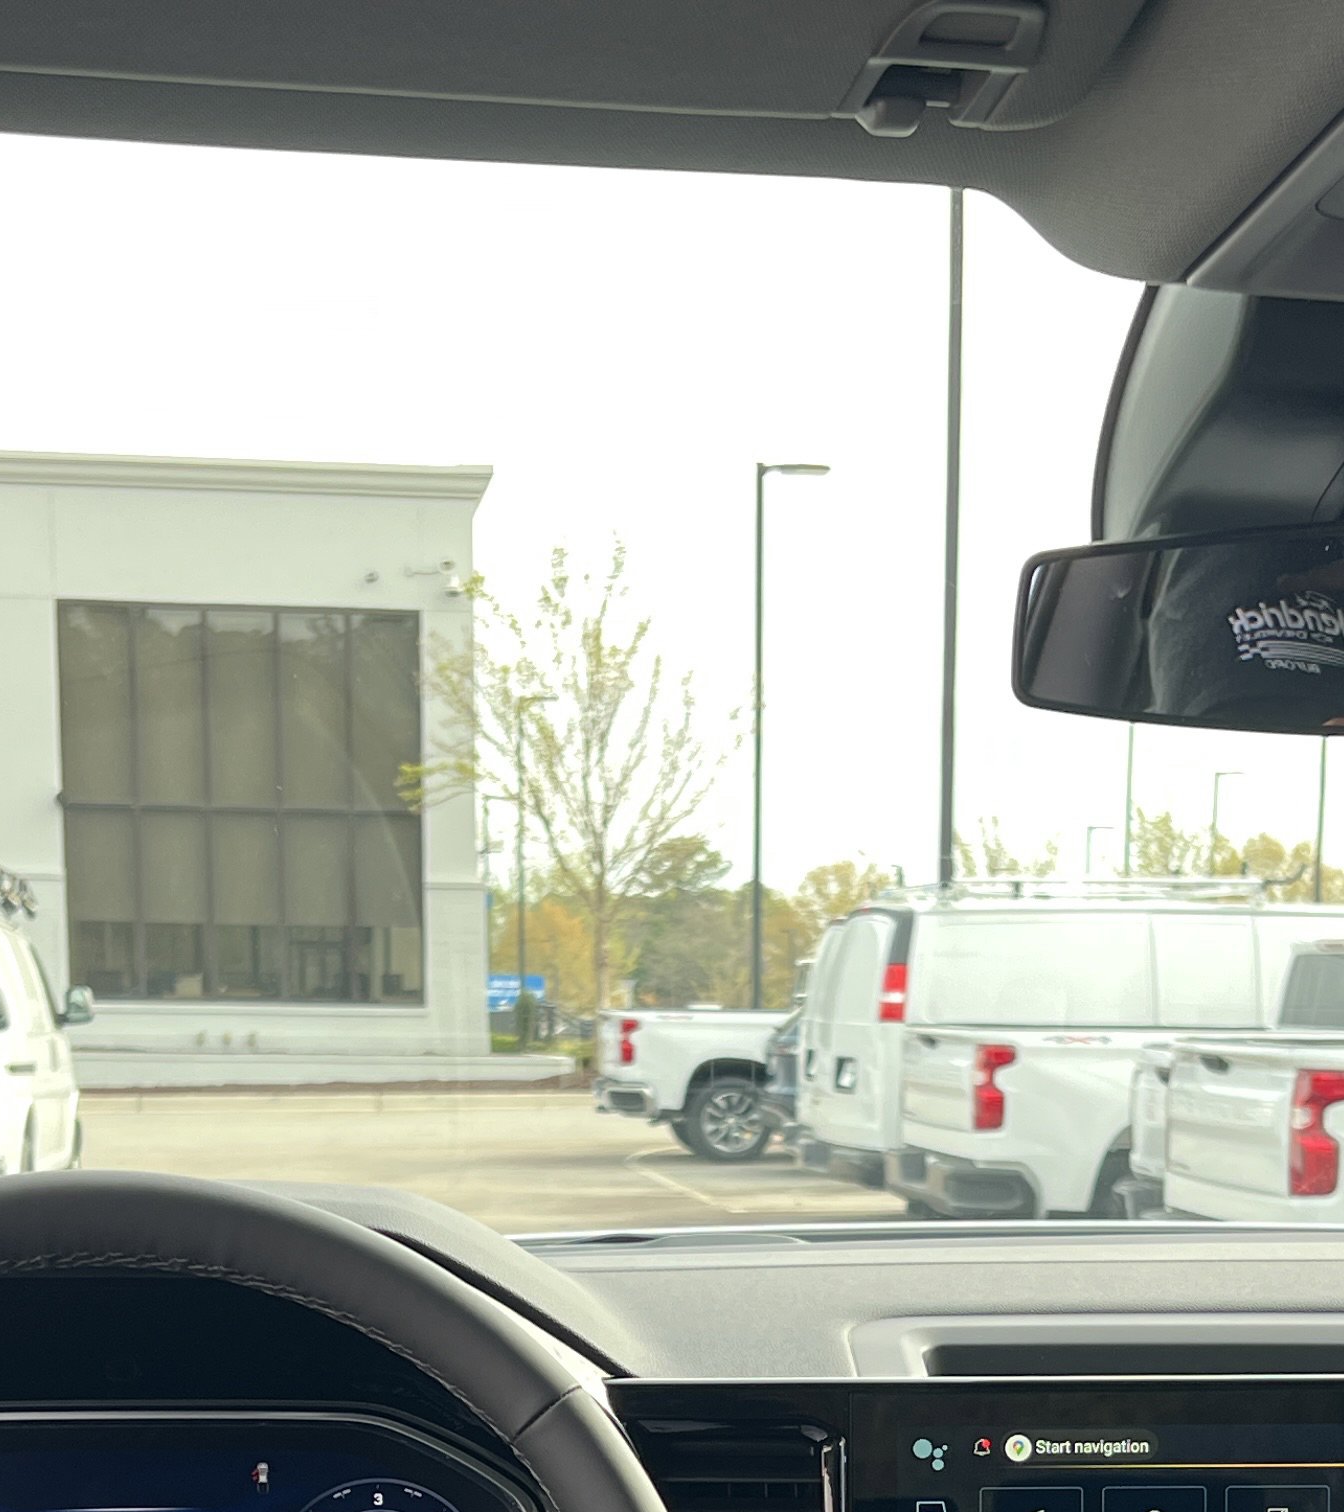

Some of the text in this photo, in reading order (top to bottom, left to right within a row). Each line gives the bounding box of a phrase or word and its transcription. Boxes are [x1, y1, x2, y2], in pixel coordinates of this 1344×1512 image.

[1036, 1439, 1149, 1457] Start navigation
[373, 1493, 384, 1506] 3
